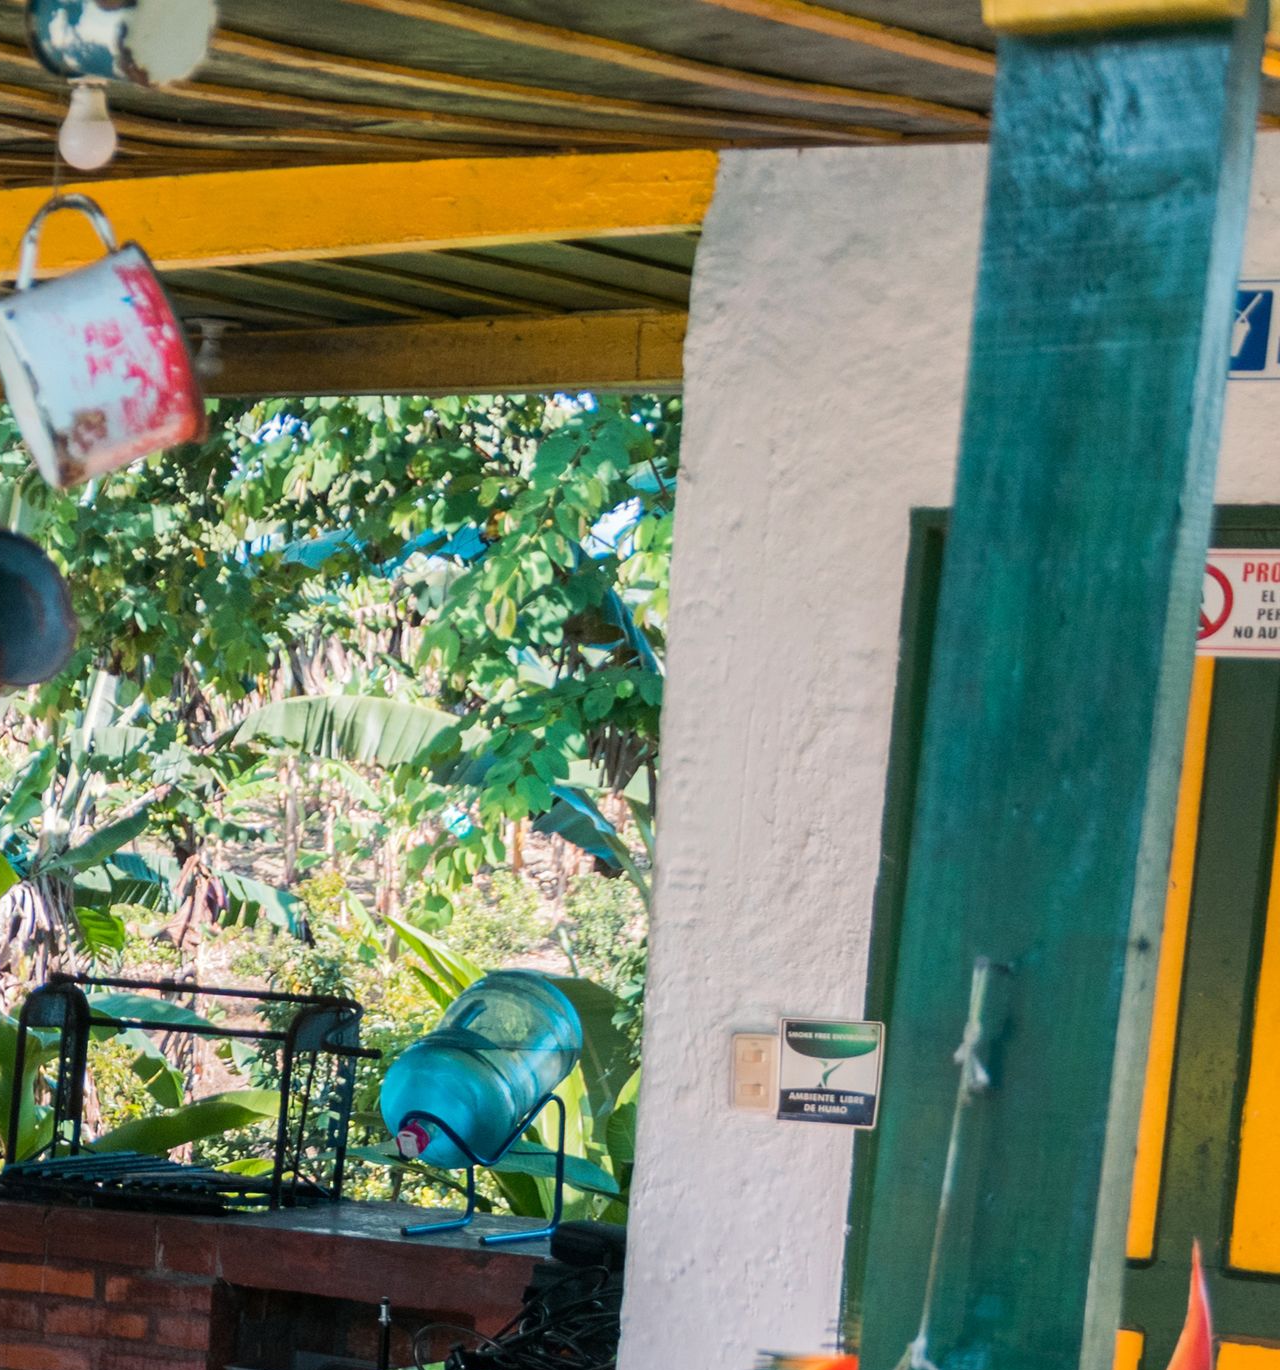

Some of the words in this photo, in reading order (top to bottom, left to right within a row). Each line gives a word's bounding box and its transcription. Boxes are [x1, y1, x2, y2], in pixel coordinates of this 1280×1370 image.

[1261, 590, 1275, 603] EL
[1233, 626, 1253, 639] NO
[787, 1031, 813, 1040] SMOKE
[814, 1032, 831, 1041] FREE
[788, 1091, 835, 1103] AMBIENTE
[840, 1095, 864, 1105] LIBRE
[803, 1103, 816, 1113] DE
[818, 1104, 848, 1114] HUMO
